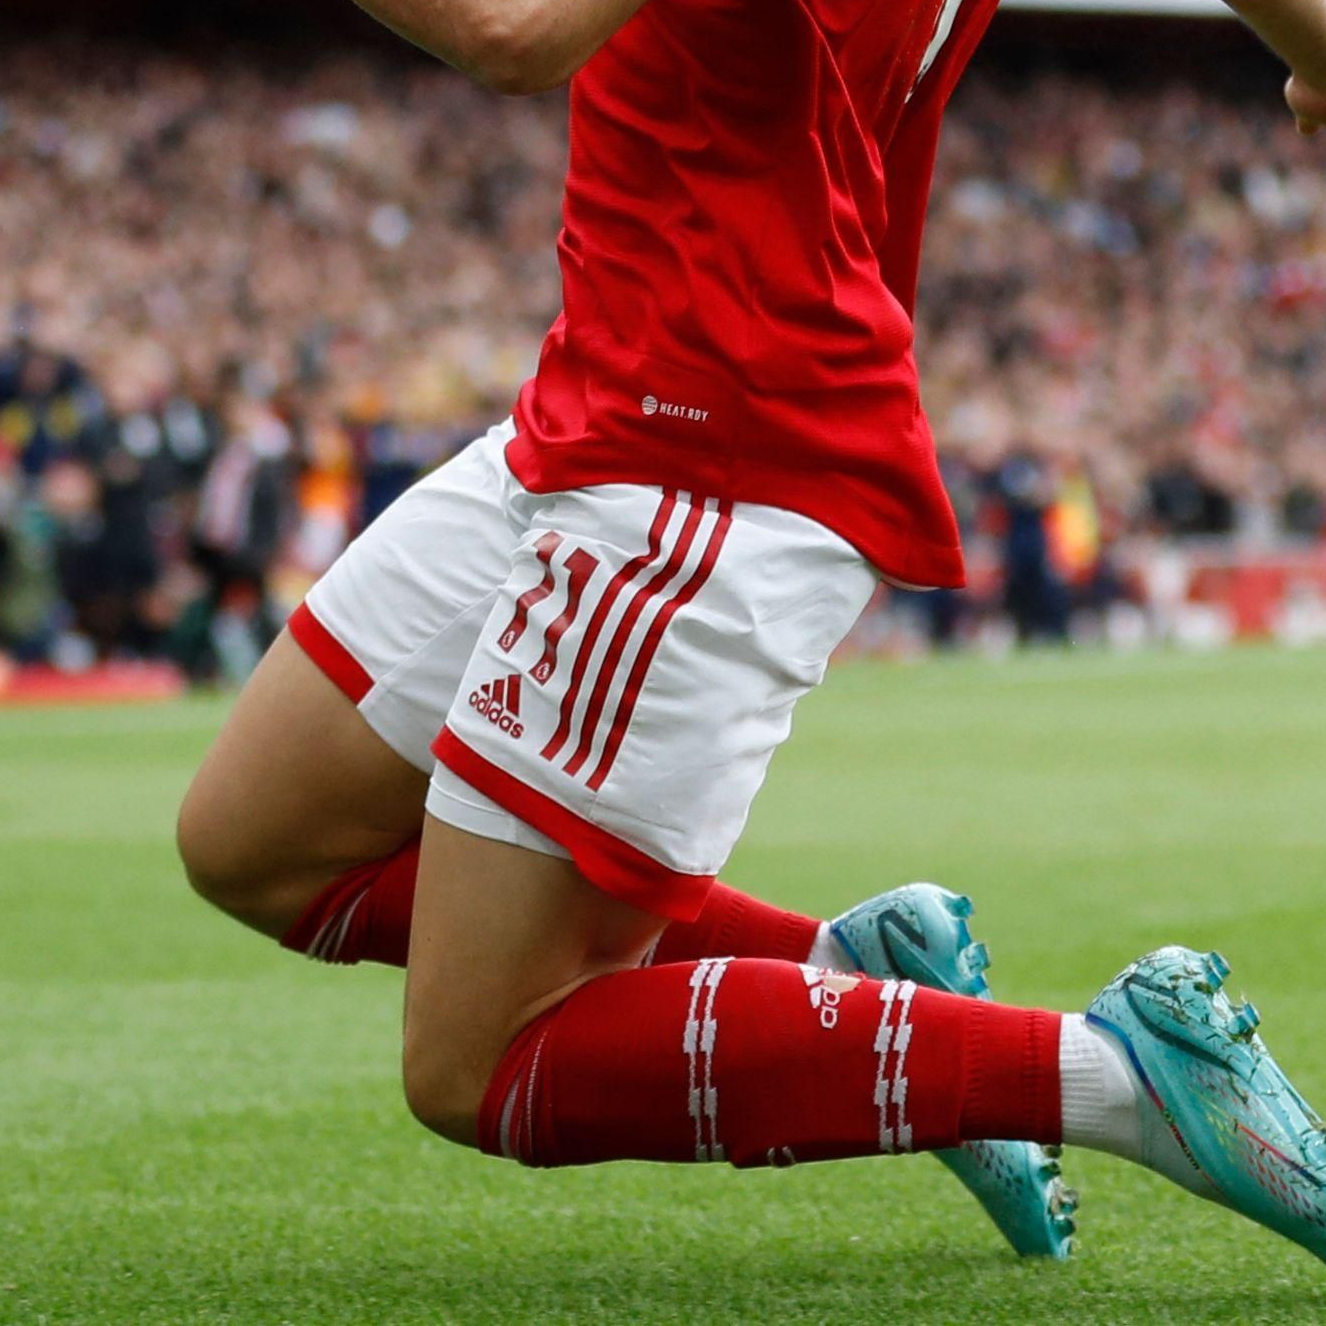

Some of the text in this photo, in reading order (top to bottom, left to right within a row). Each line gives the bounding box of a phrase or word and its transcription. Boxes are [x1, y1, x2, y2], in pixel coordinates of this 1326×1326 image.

[659, 402, 709, 422] HEAT.RDY
[497, 529, 601, 687] 11
[468, 690, 524, 739] adidas
